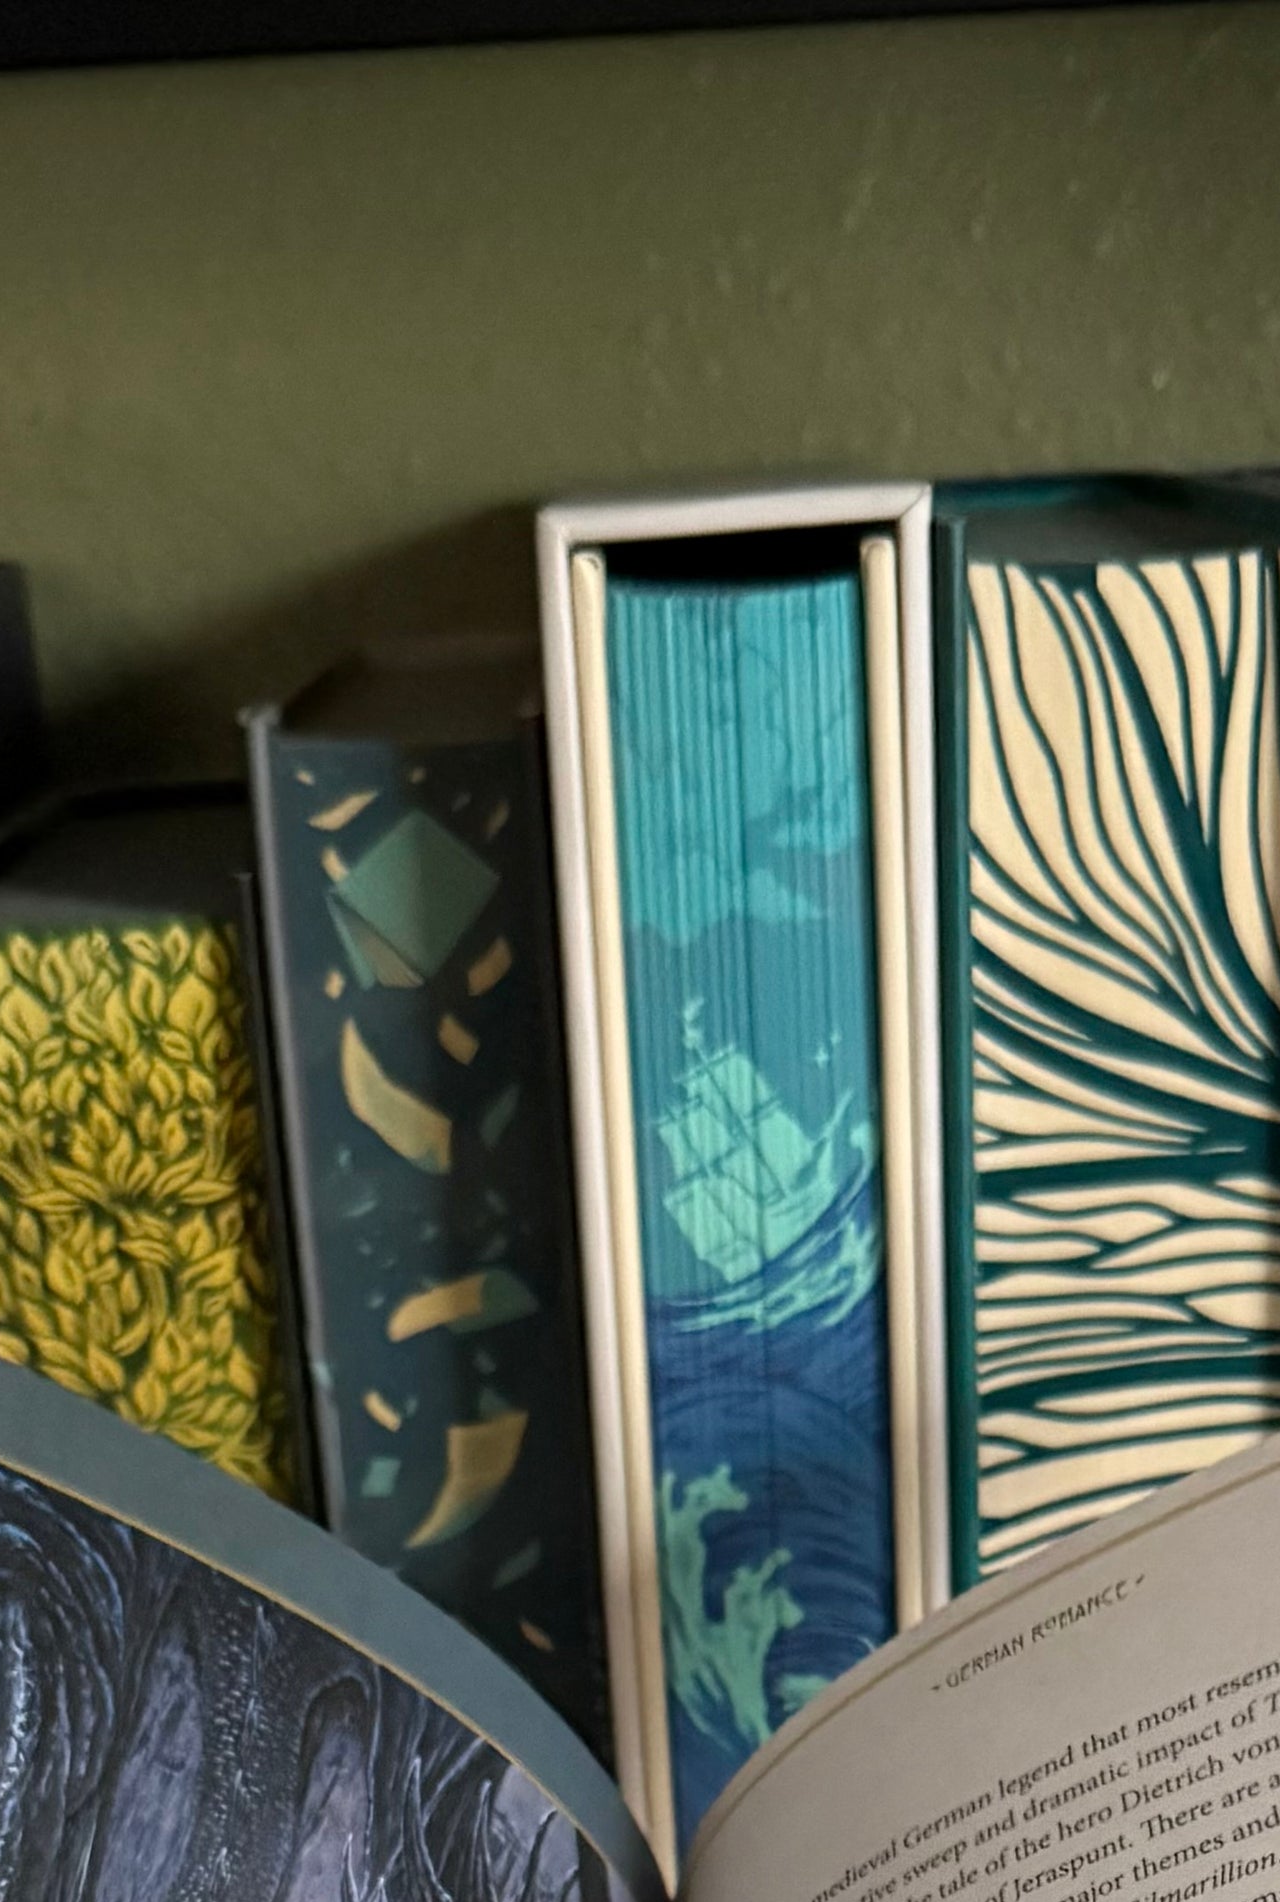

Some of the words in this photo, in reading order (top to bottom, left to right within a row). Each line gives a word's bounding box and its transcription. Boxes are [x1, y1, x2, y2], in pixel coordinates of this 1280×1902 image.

[946, 1635, 1025, 1690] GERMAN
[1032, 1579, 1128, 1643] ROMANCE
[903, 1793, 991, 1848] German
[999, 1745, 1073, 1799] legend
[1082, 1725, 1127, 1758] that
[1138, 1694, 1196, 1734] most
